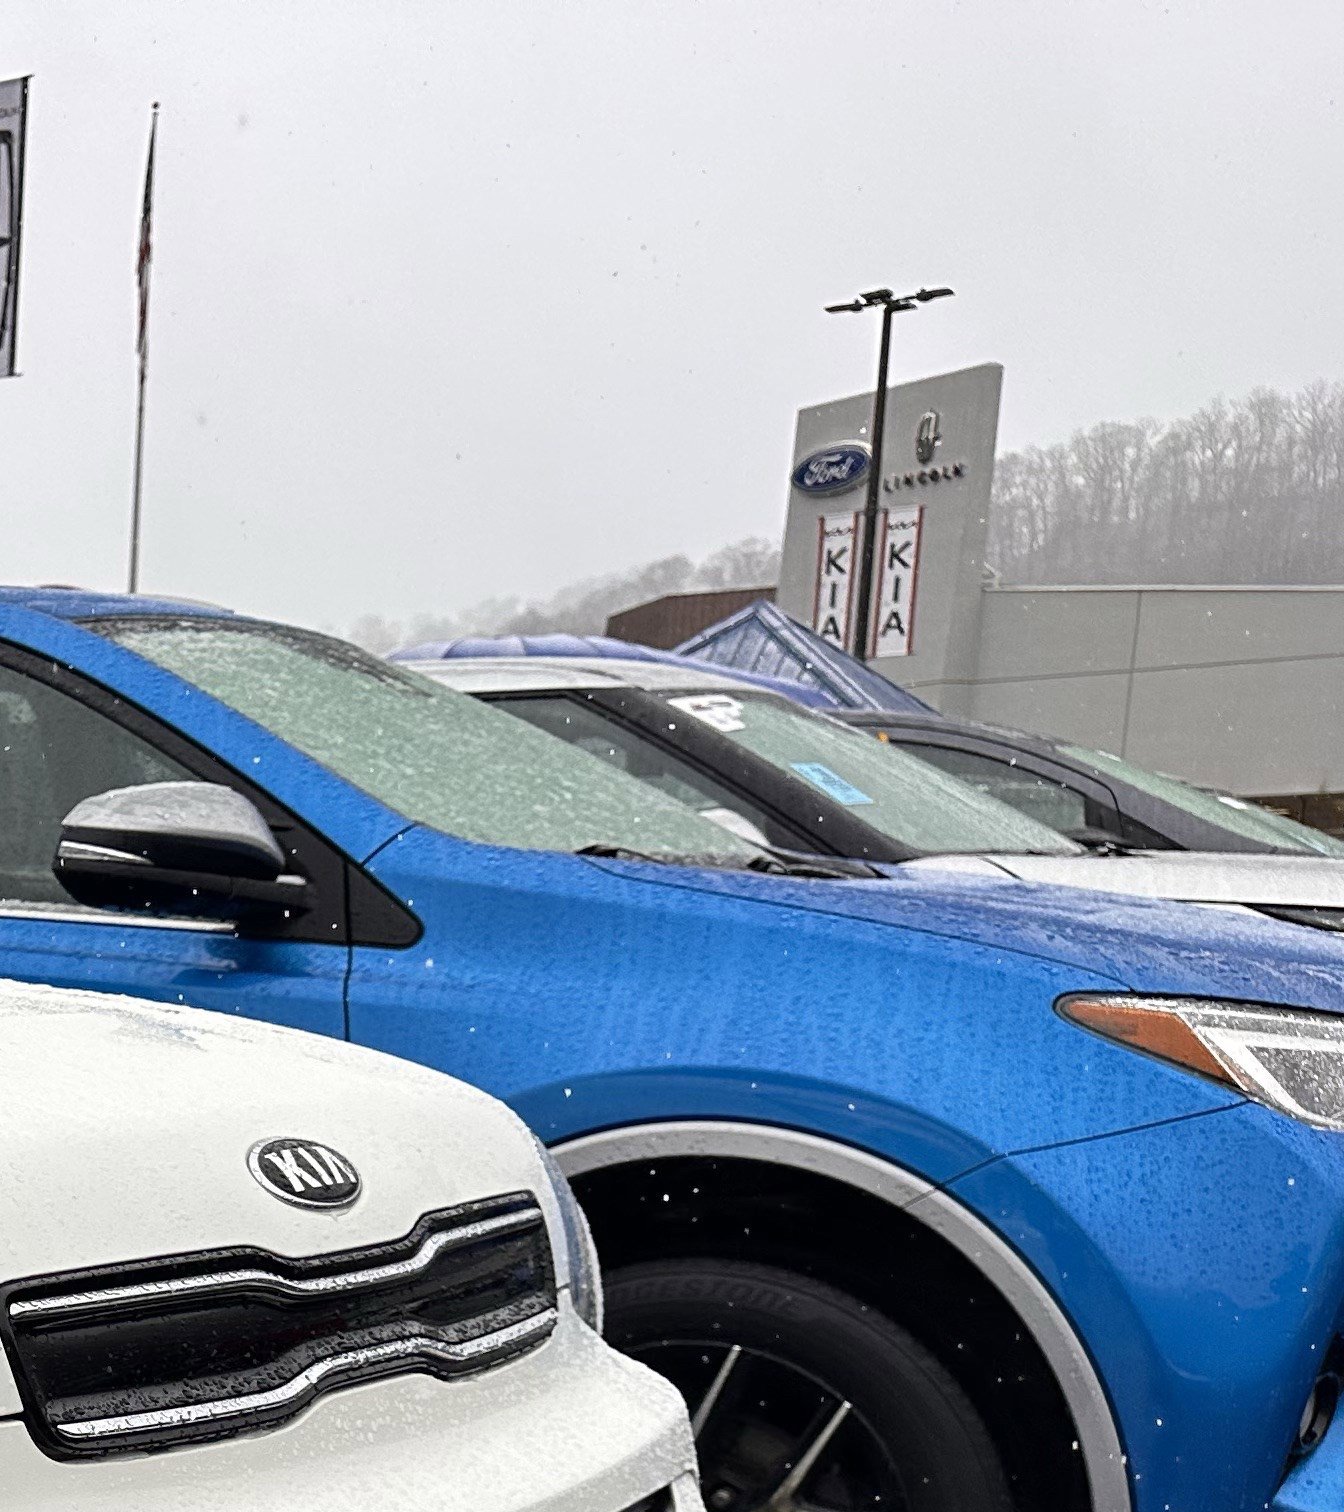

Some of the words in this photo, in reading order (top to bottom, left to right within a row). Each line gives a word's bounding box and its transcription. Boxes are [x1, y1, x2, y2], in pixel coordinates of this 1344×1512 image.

[803, 453, 855, 487] Ford
[821, 545, 849, 640] KIA
[880, 540, 913, 637] KIA
[264, 1145, 358, 1193] KIA
